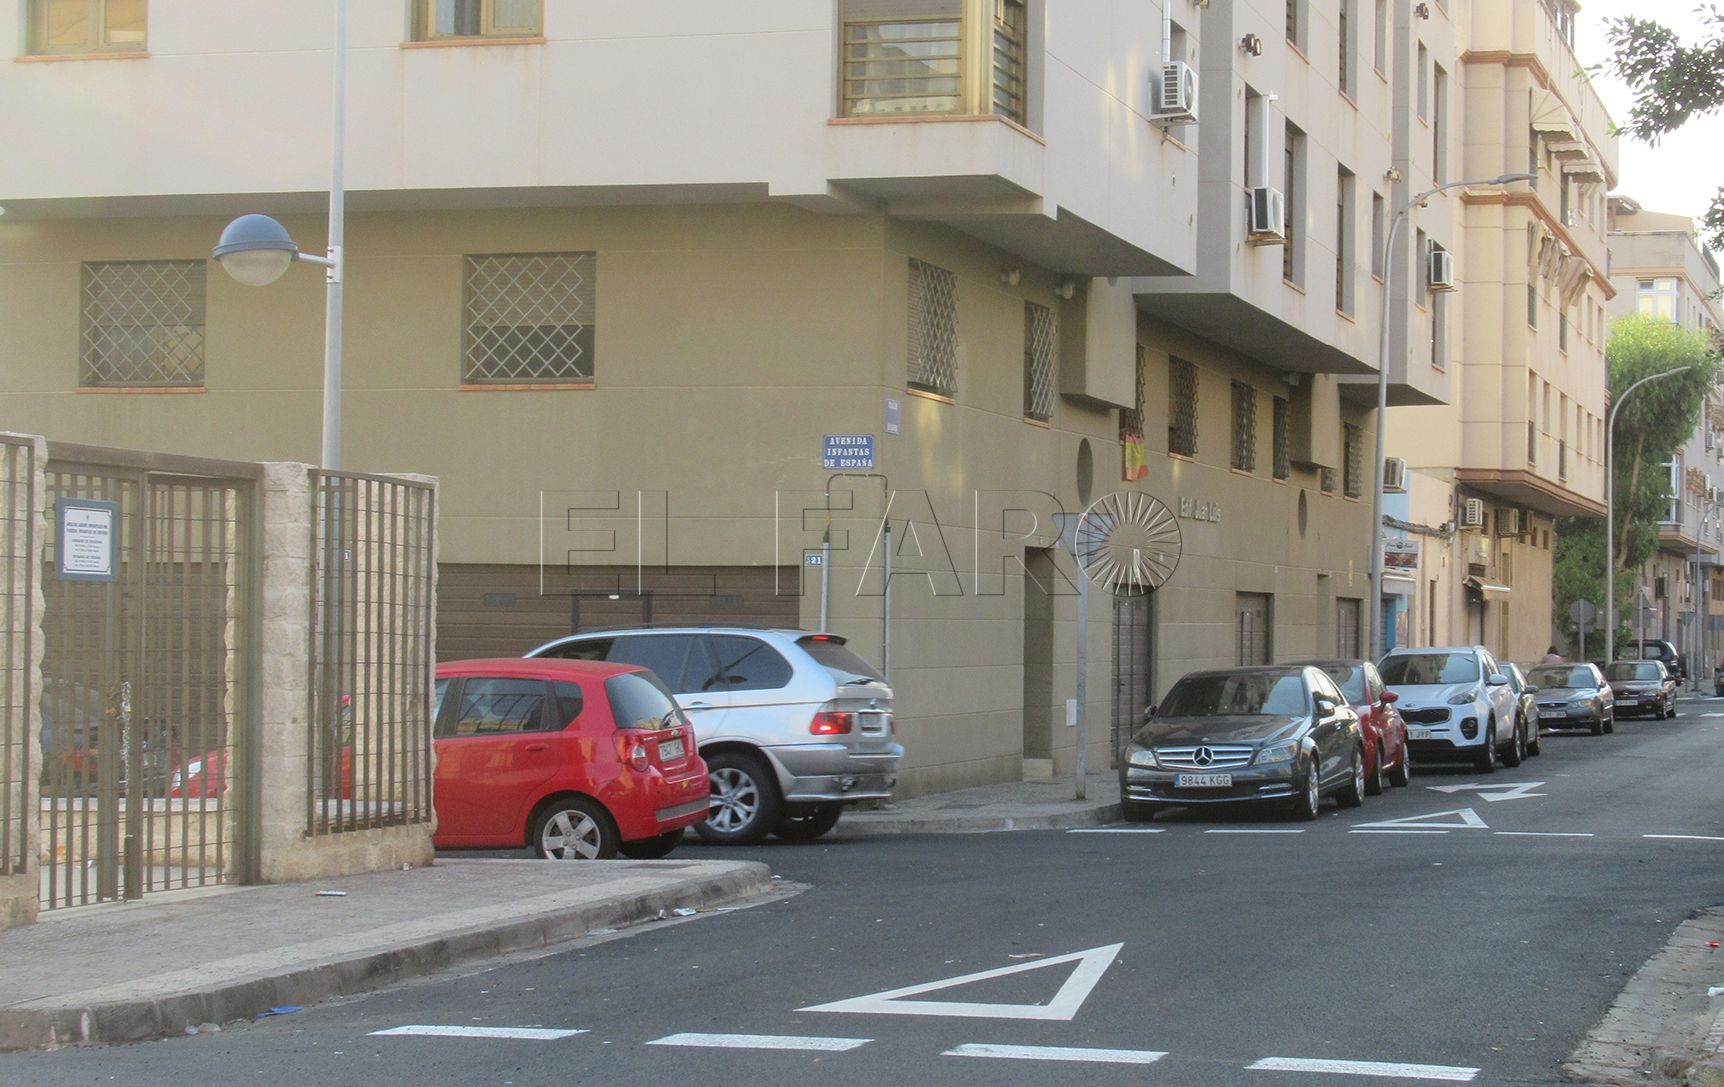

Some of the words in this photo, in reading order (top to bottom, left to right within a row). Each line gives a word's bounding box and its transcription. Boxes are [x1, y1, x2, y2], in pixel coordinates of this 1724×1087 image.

[830, 437, 868, 445] AVENIDA
[827, 448, 870, 456] INFANTAS
[824, 459, 835, 467] DE
[840, 458, 873, 467] ESPAÑA
[810, 556, 821, 565] 21
[1181, 775, 1206, 785] 9844
[1209, 775, 1230, 785] KGG
